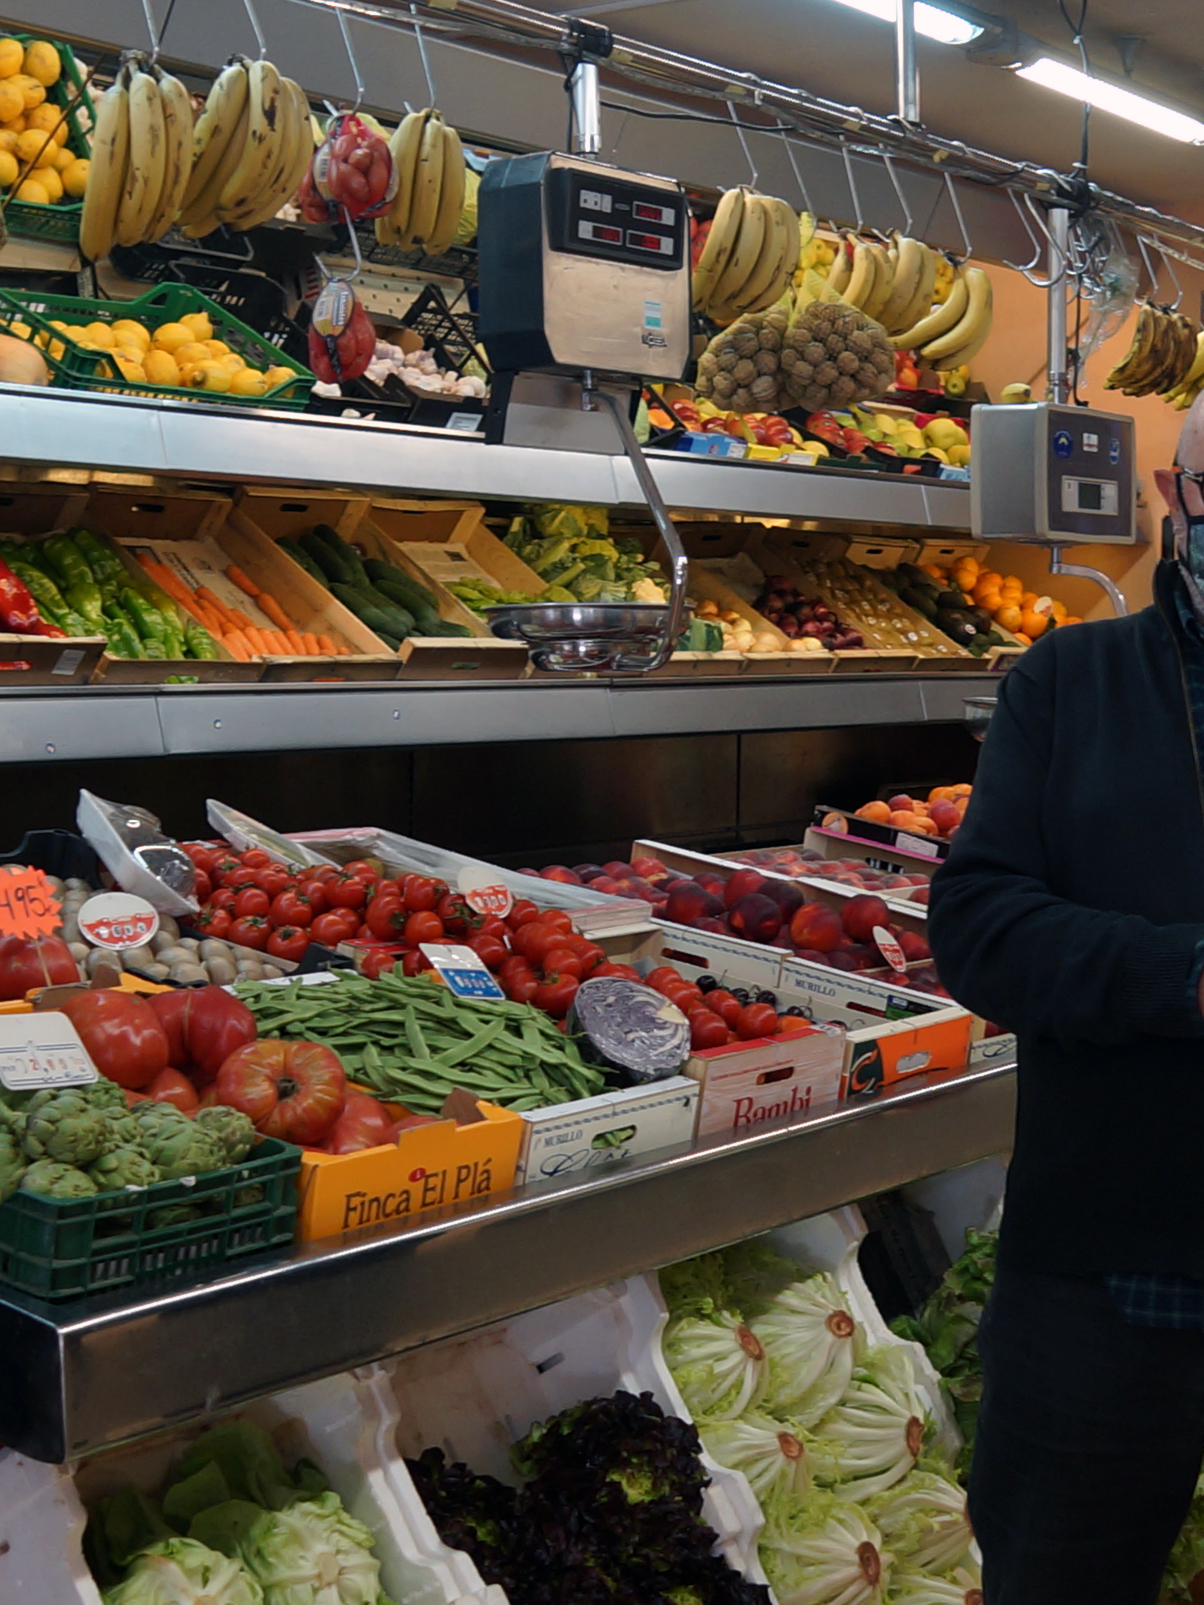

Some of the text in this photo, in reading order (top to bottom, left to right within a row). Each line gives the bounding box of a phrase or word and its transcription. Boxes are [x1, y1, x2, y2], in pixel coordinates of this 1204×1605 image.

[794, 979, 836, 997] MURILLO
[543, 1129, 584, 1148] MURILLO
[341, 1190, 411, 1231] Finca
[419, 1168, 447, 1209] El
[452, 1157, 493, 1200] Plá
